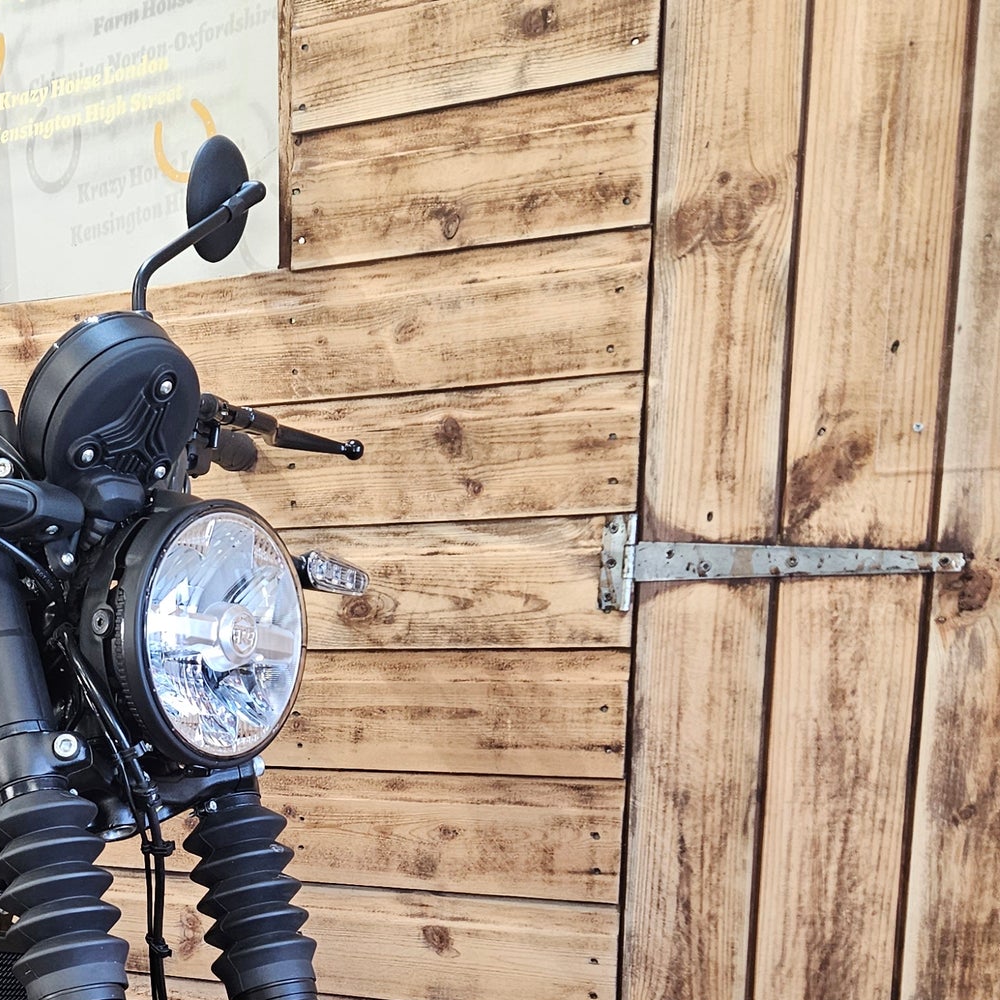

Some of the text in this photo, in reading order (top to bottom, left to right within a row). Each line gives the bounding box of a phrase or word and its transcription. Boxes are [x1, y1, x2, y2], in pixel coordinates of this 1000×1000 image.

[50, 75, 100, 99] Horse
[102, 54, 169, 86] London
[84, 95, 127, 124] High
[129, 84, 183, 112] Street
